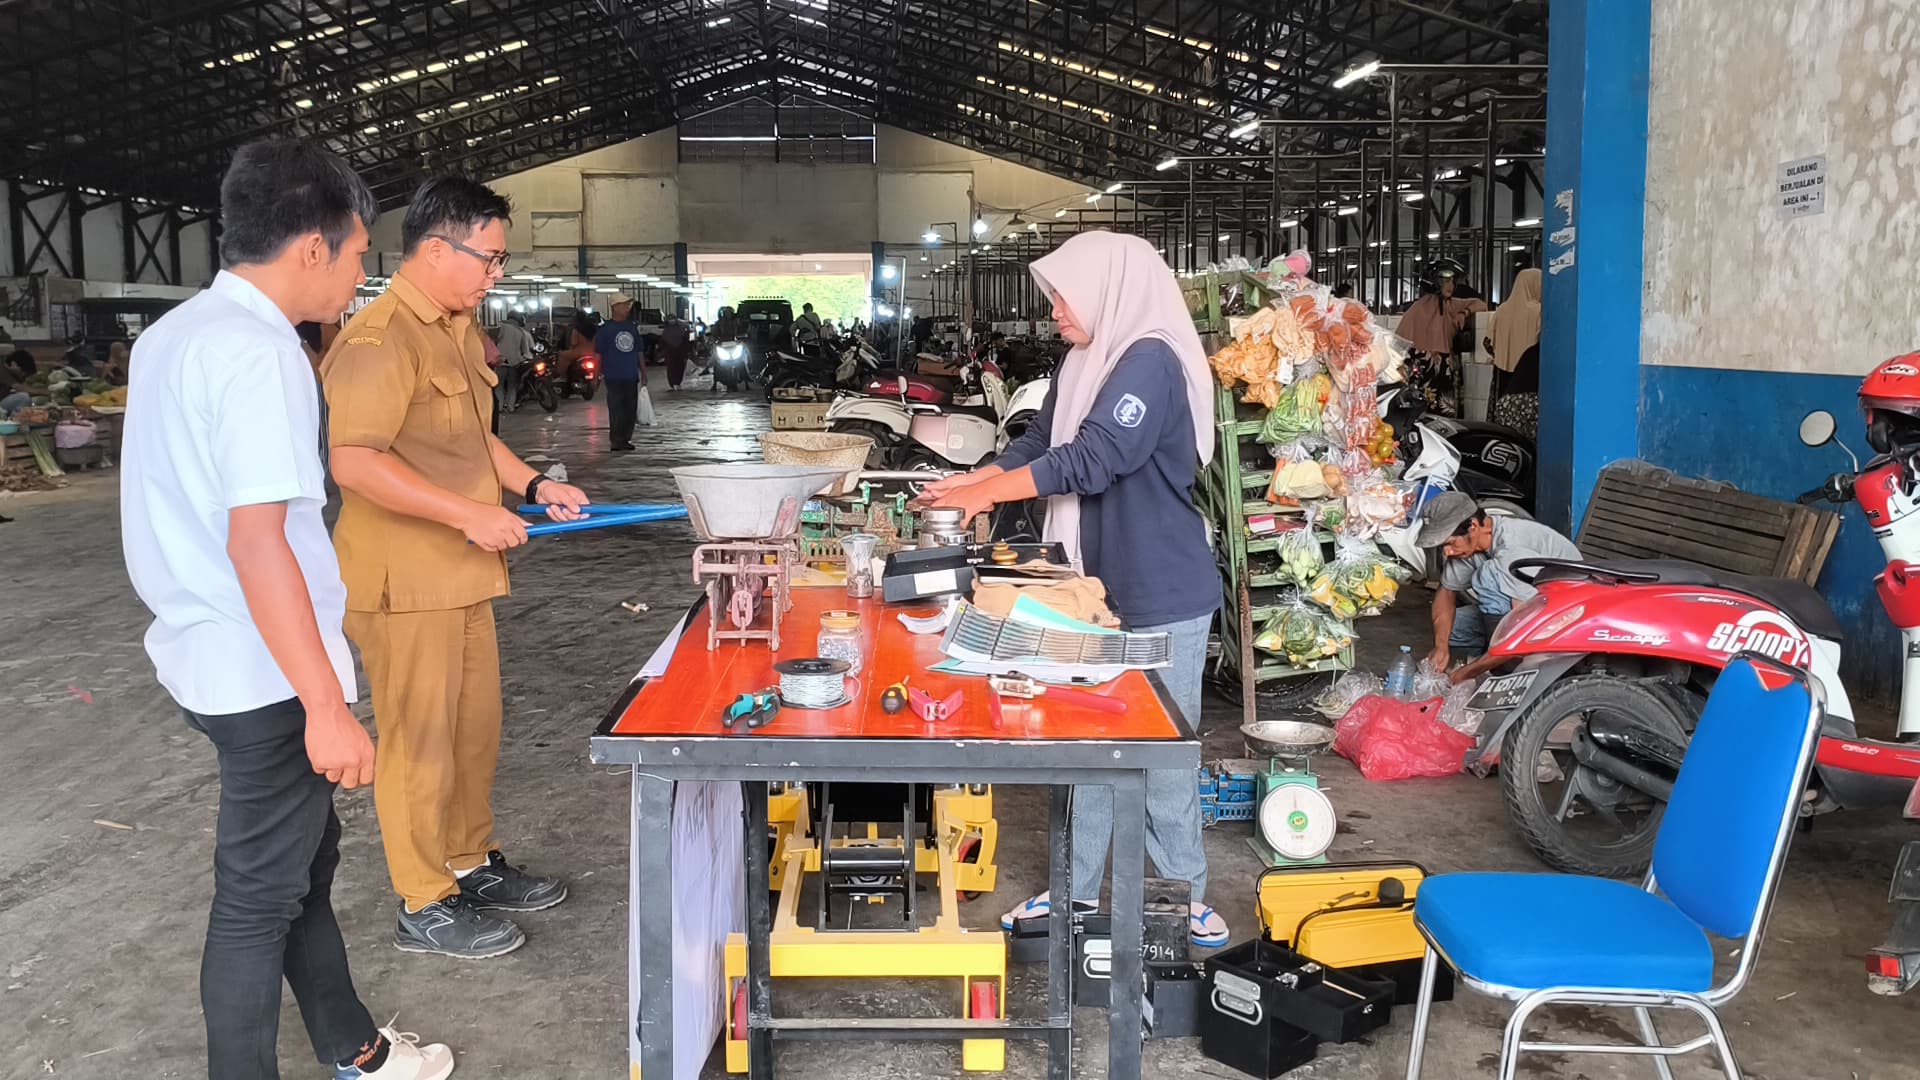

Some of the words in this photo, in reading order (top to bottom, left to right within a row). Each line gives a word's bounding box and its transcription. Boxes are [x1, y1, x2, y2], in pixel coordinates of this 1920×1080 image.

[1787, 162, 1817, 176] DILARANG
[1780, 178, 1815, 192] BERJUALAN
[1816, 176, 1824, 184] DI
[1783, 196, 1799, 206] AREA
[1800, 193, 1809, 203] INI
[1588, 629, 1671, 646] Scoopy
[1706, 622, 1809, 667] SCOOPY
[1142, 944, 1175, 961] 7914
